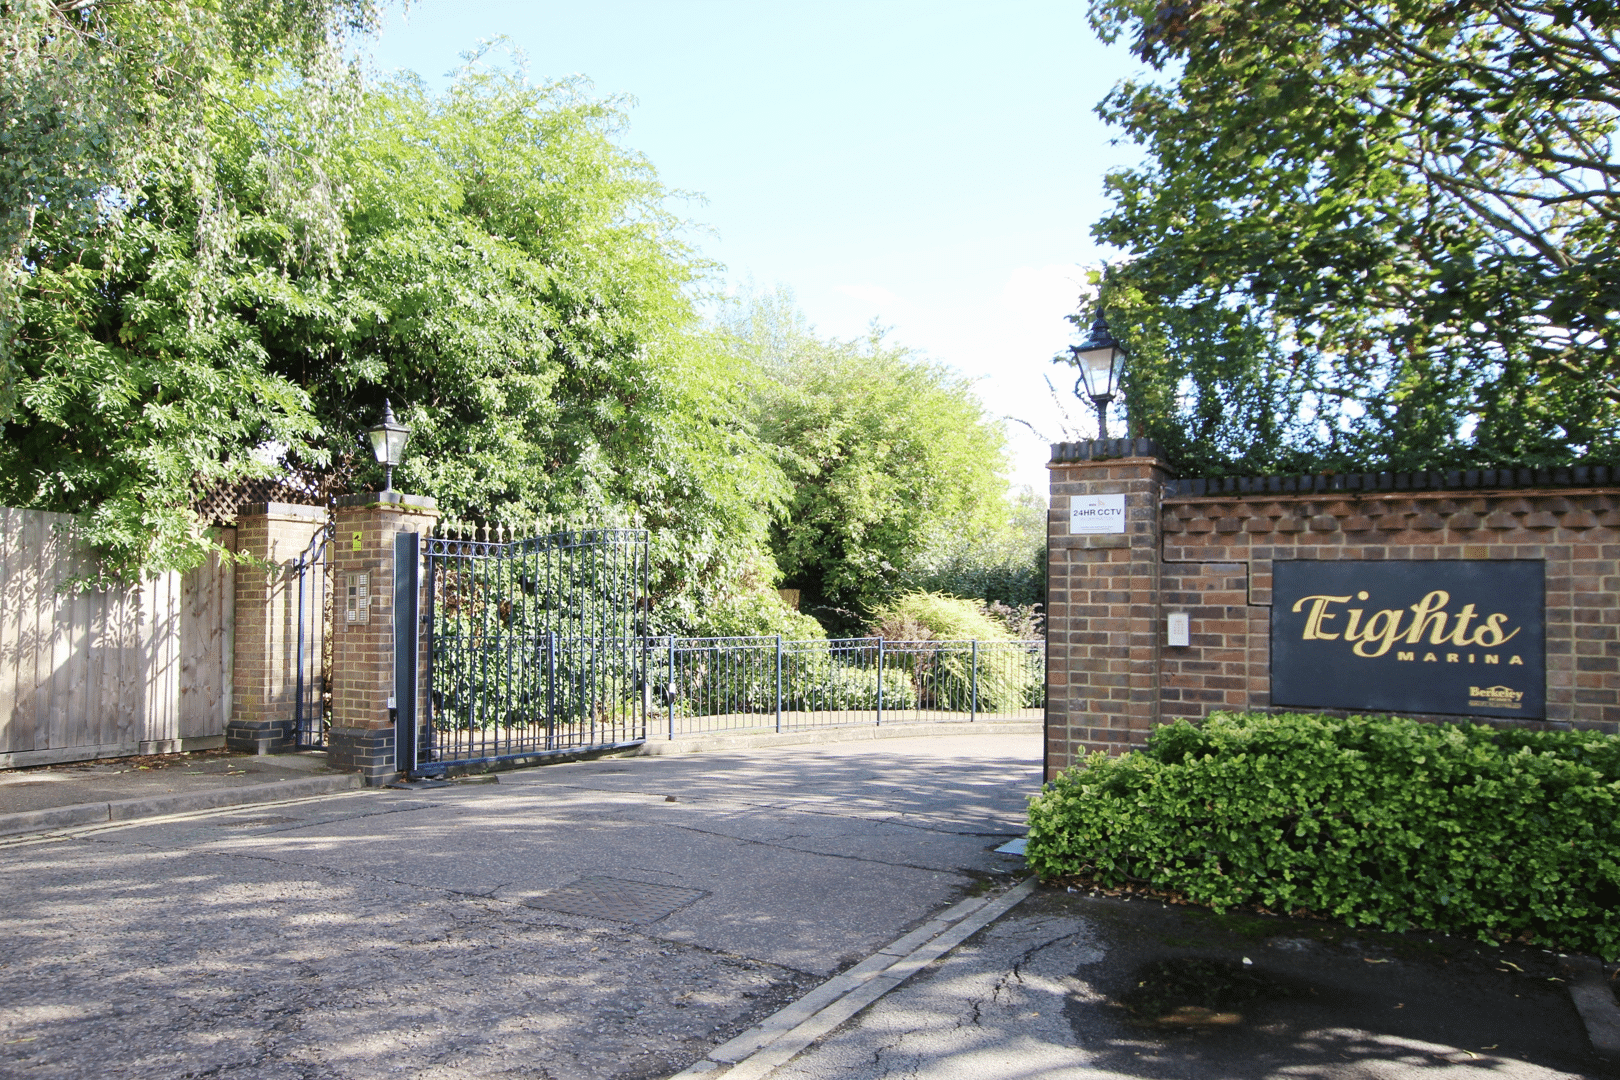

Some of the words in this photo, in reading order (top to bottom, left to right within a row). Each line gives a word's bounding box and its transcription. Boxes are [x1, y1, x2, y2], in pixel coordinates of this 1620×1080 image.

[1097, 508, 1122, 516] CCTV
[1292, 589, 1521, 658] Eights
[1397, 651, 1524, 666] MARINA
[1468, 686, 1524, 702] Berkeley
